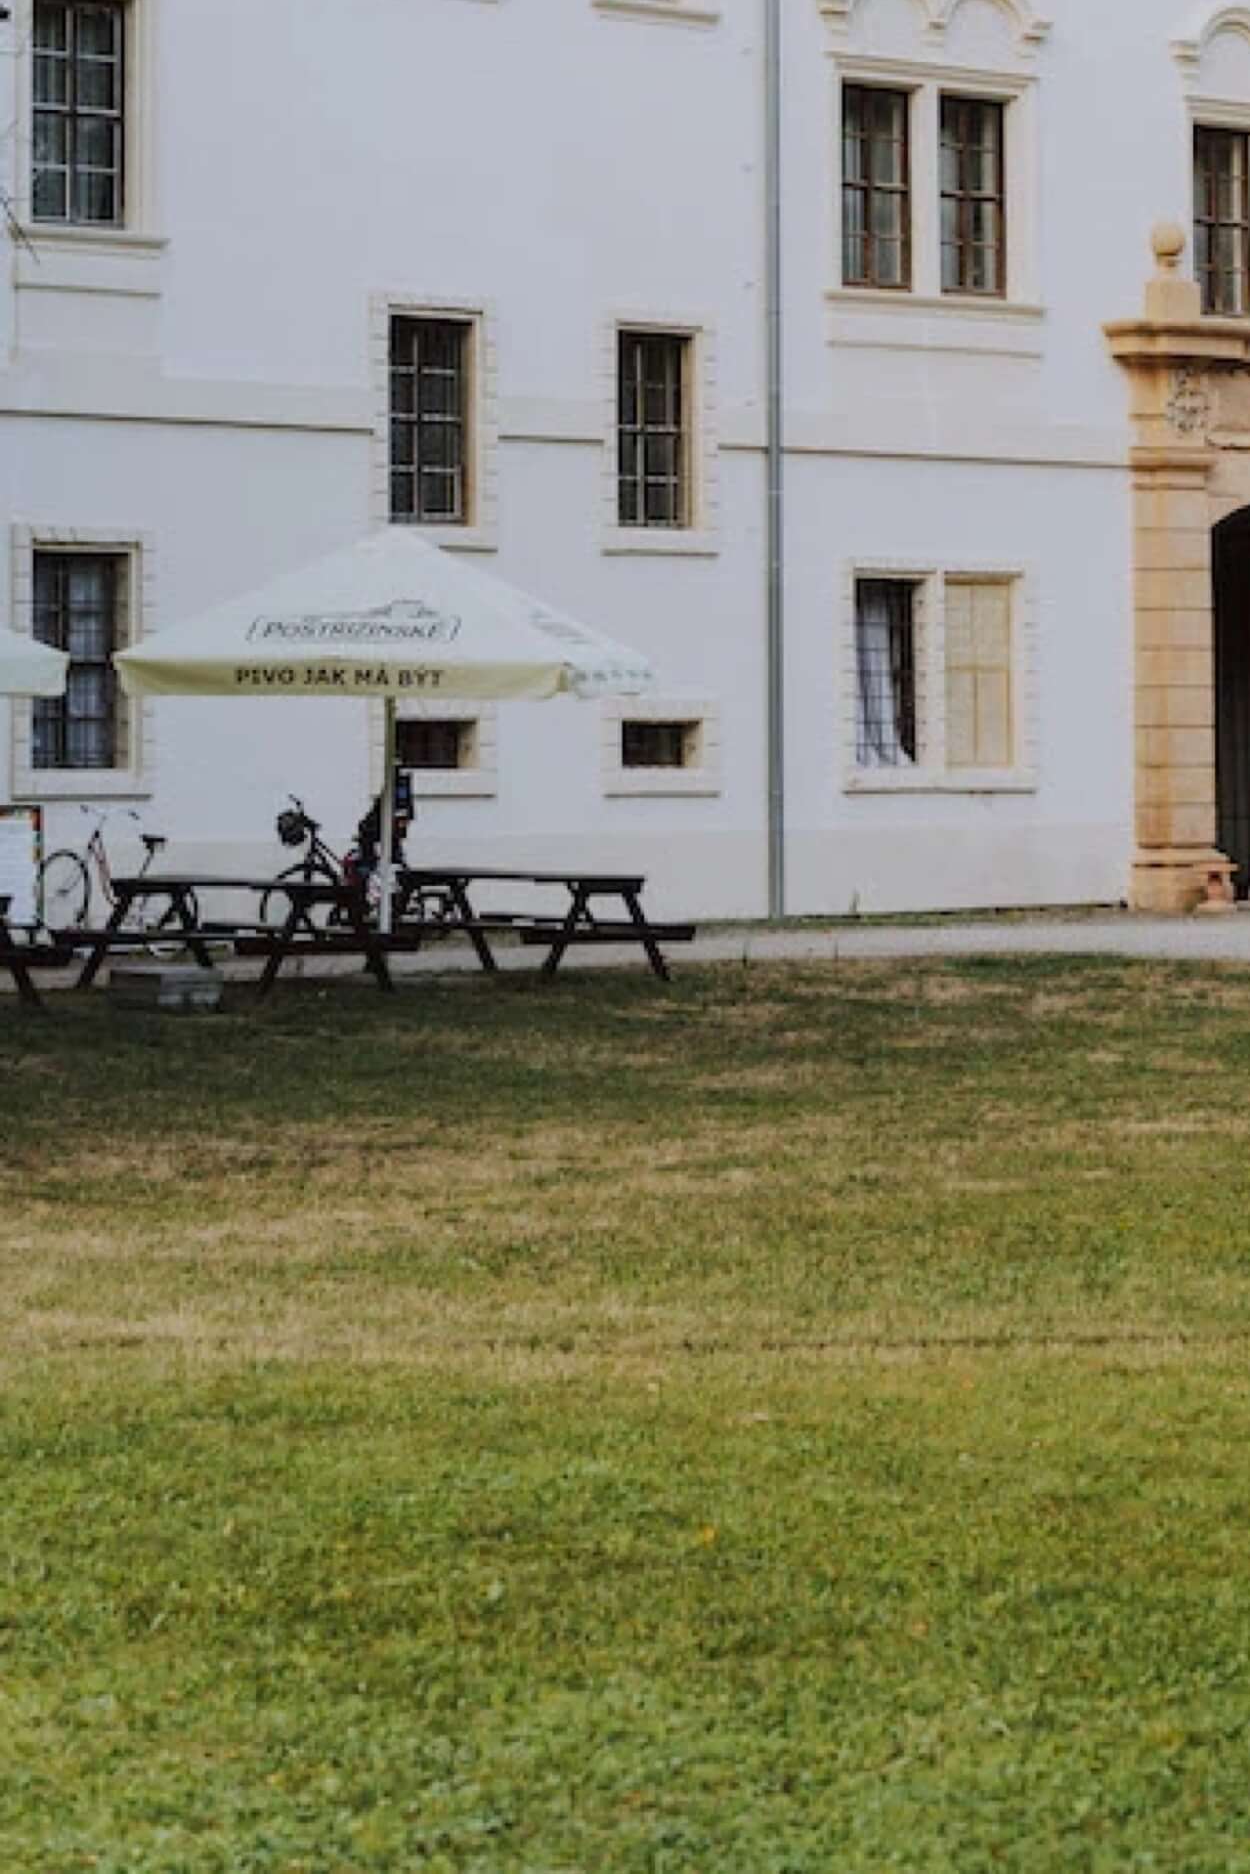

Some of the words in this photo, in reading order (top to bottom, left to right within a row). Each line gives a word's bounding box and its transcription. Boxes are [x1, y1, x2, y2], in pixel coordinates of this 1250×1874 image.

[236, 669, 296, 686] PIVO
[303, 669, 346, 686] JAK
[354, 662, 389, 686] MÁ
[398, 664, 444, 688] BÝT
